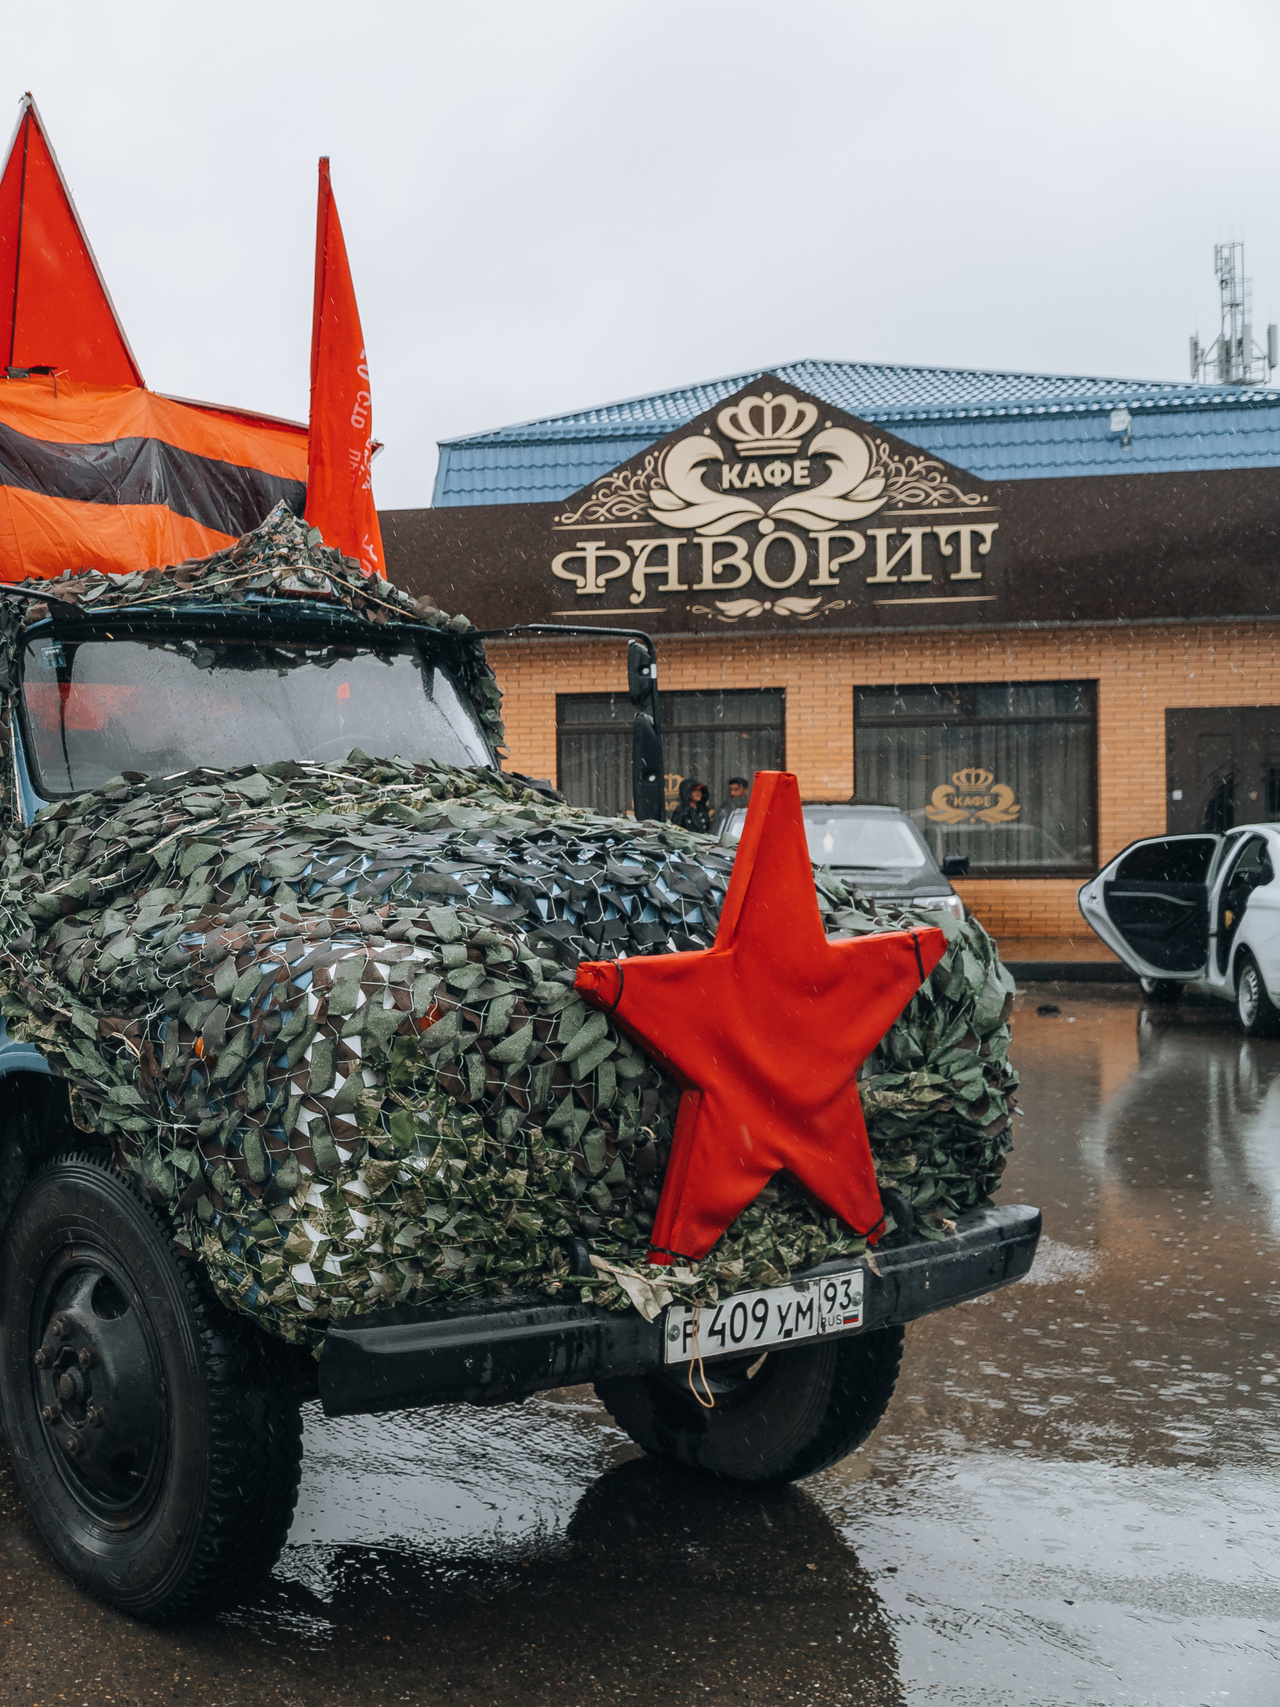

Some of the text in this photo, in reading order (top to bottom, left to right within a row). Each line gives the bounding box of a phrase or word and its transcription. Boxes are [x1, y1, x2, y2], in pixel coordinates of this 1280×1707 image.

[722, 459, 811, 489] КАФЕ
[551, 522, 999, 603] ФАВОРИТ
[953, 795, 991, 808] КАФЕ
[823, 1279, 852, 1315] 93
[821, 1314, 842, 1328] RUS
